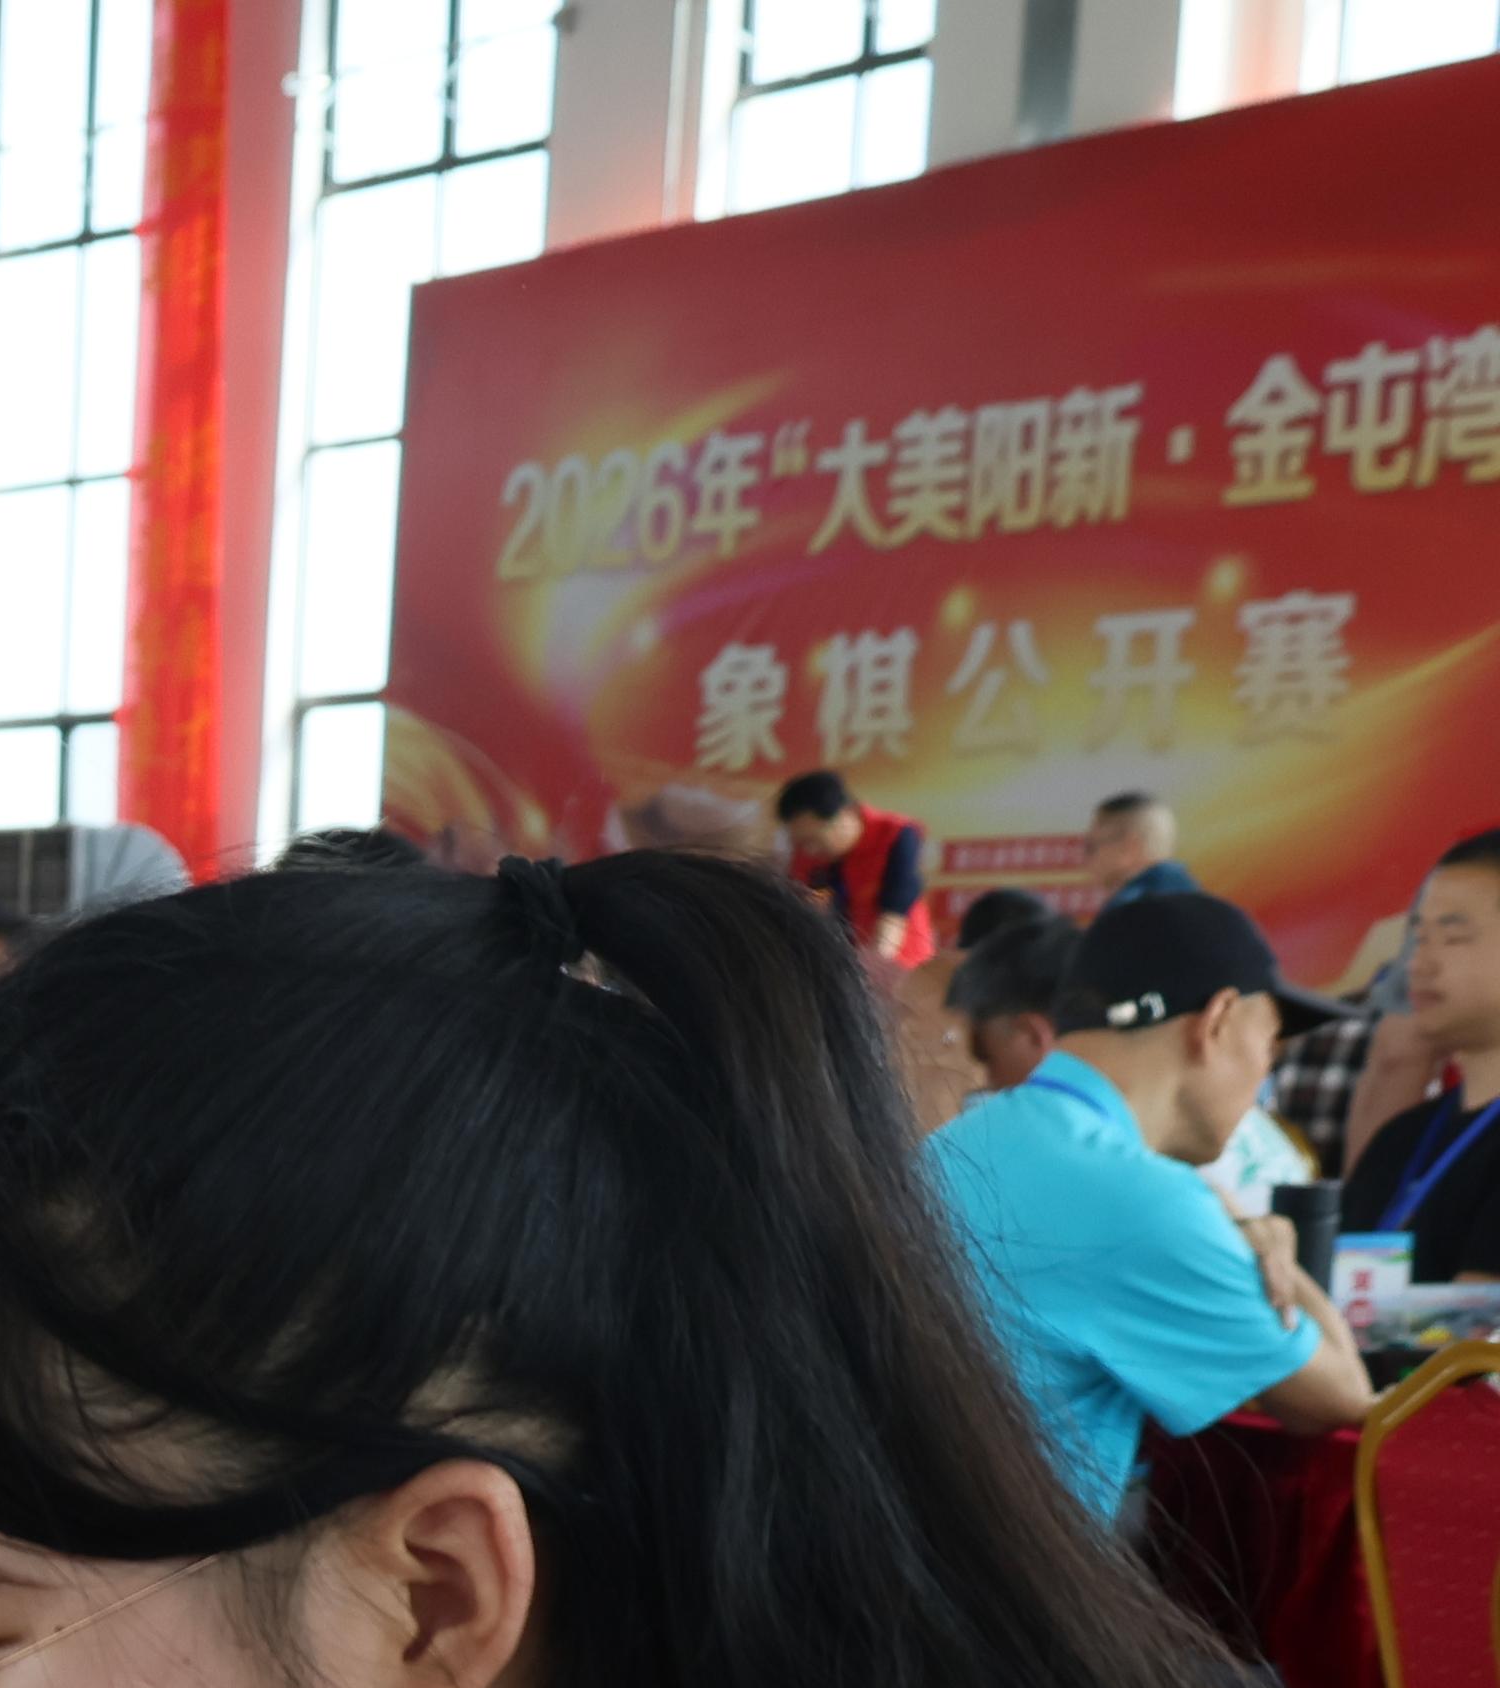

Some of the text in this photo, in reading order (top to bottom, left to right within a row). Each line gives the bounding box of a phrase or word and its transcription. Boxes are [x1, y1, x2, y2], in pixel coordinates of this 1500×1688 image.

[694, 589, 1357, 773] 象棋公开赛
